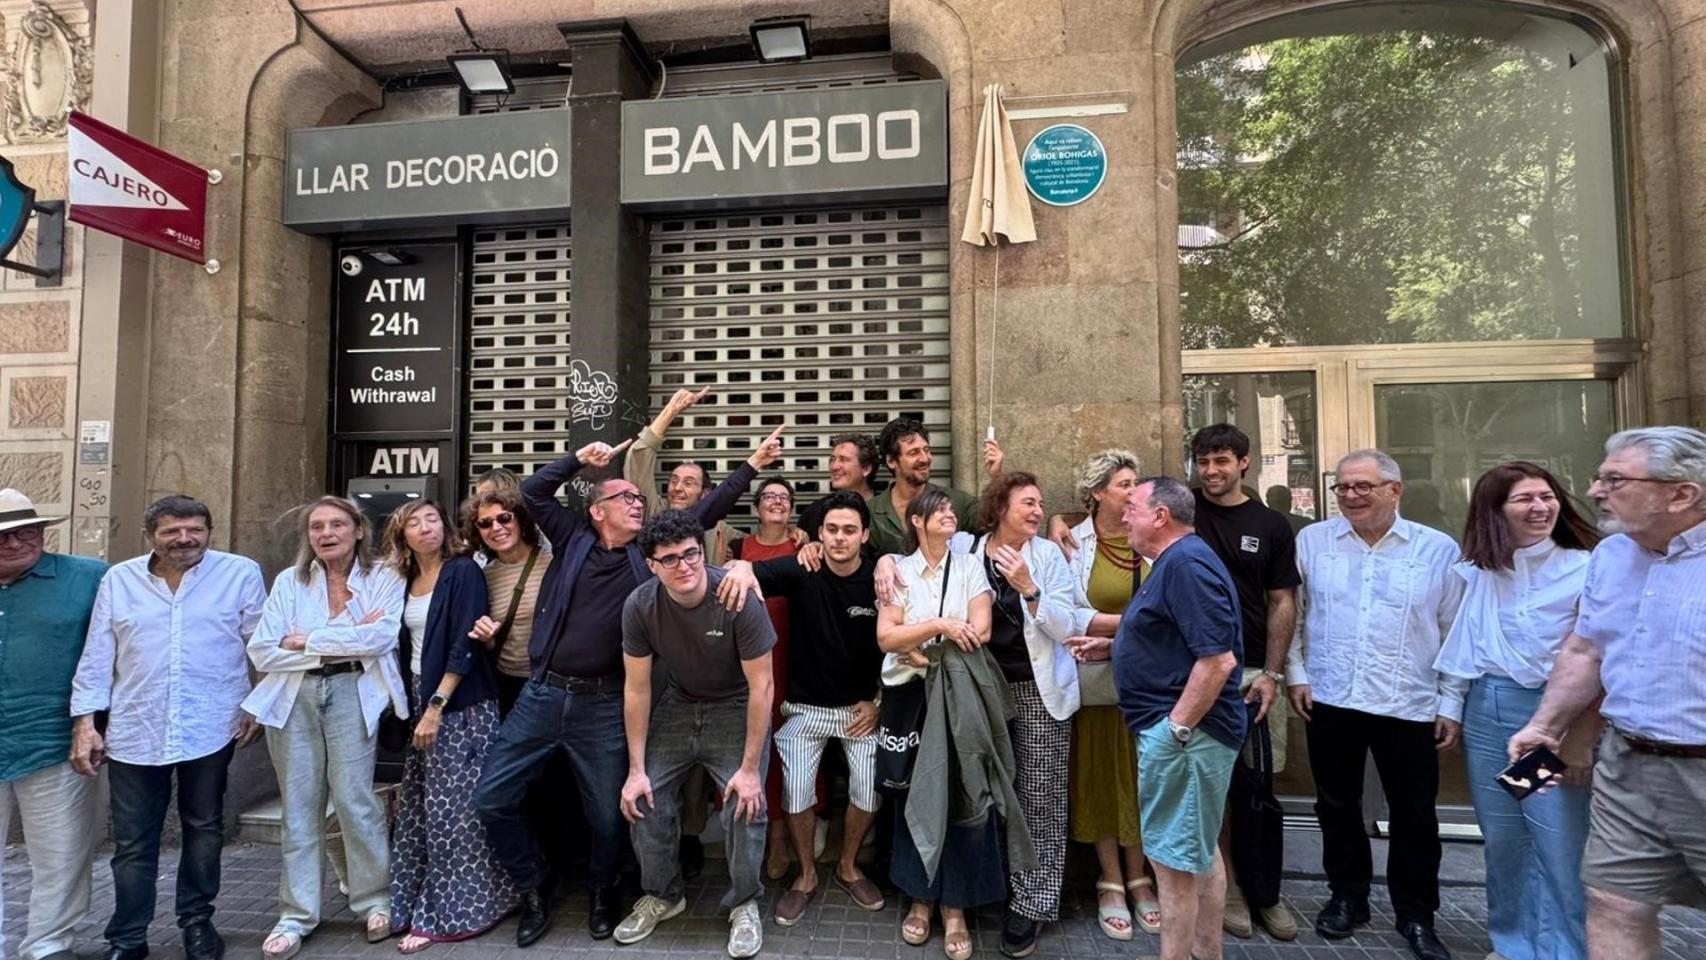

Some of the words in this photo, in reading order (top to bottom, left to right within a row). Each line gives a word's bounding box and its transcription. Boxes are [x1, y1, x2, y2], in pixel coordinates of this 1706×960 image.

[644, 109, 920, 176] BAMBOO
[1030, 151, 1057, 161] ORIOL
[1058, 150, 1098, 159] BOHIGAS
[73, 158, 168, 207] CAJERO
[296, 163, 370, 196] LLAR
[365, 277, 426, 303] ATM
[369, 312, 420, 337] 24h
[371, 366, 416, 382] Cash
[350, 387, 436, 404] Withrawal
[369, 447, 439, 475] ATM
